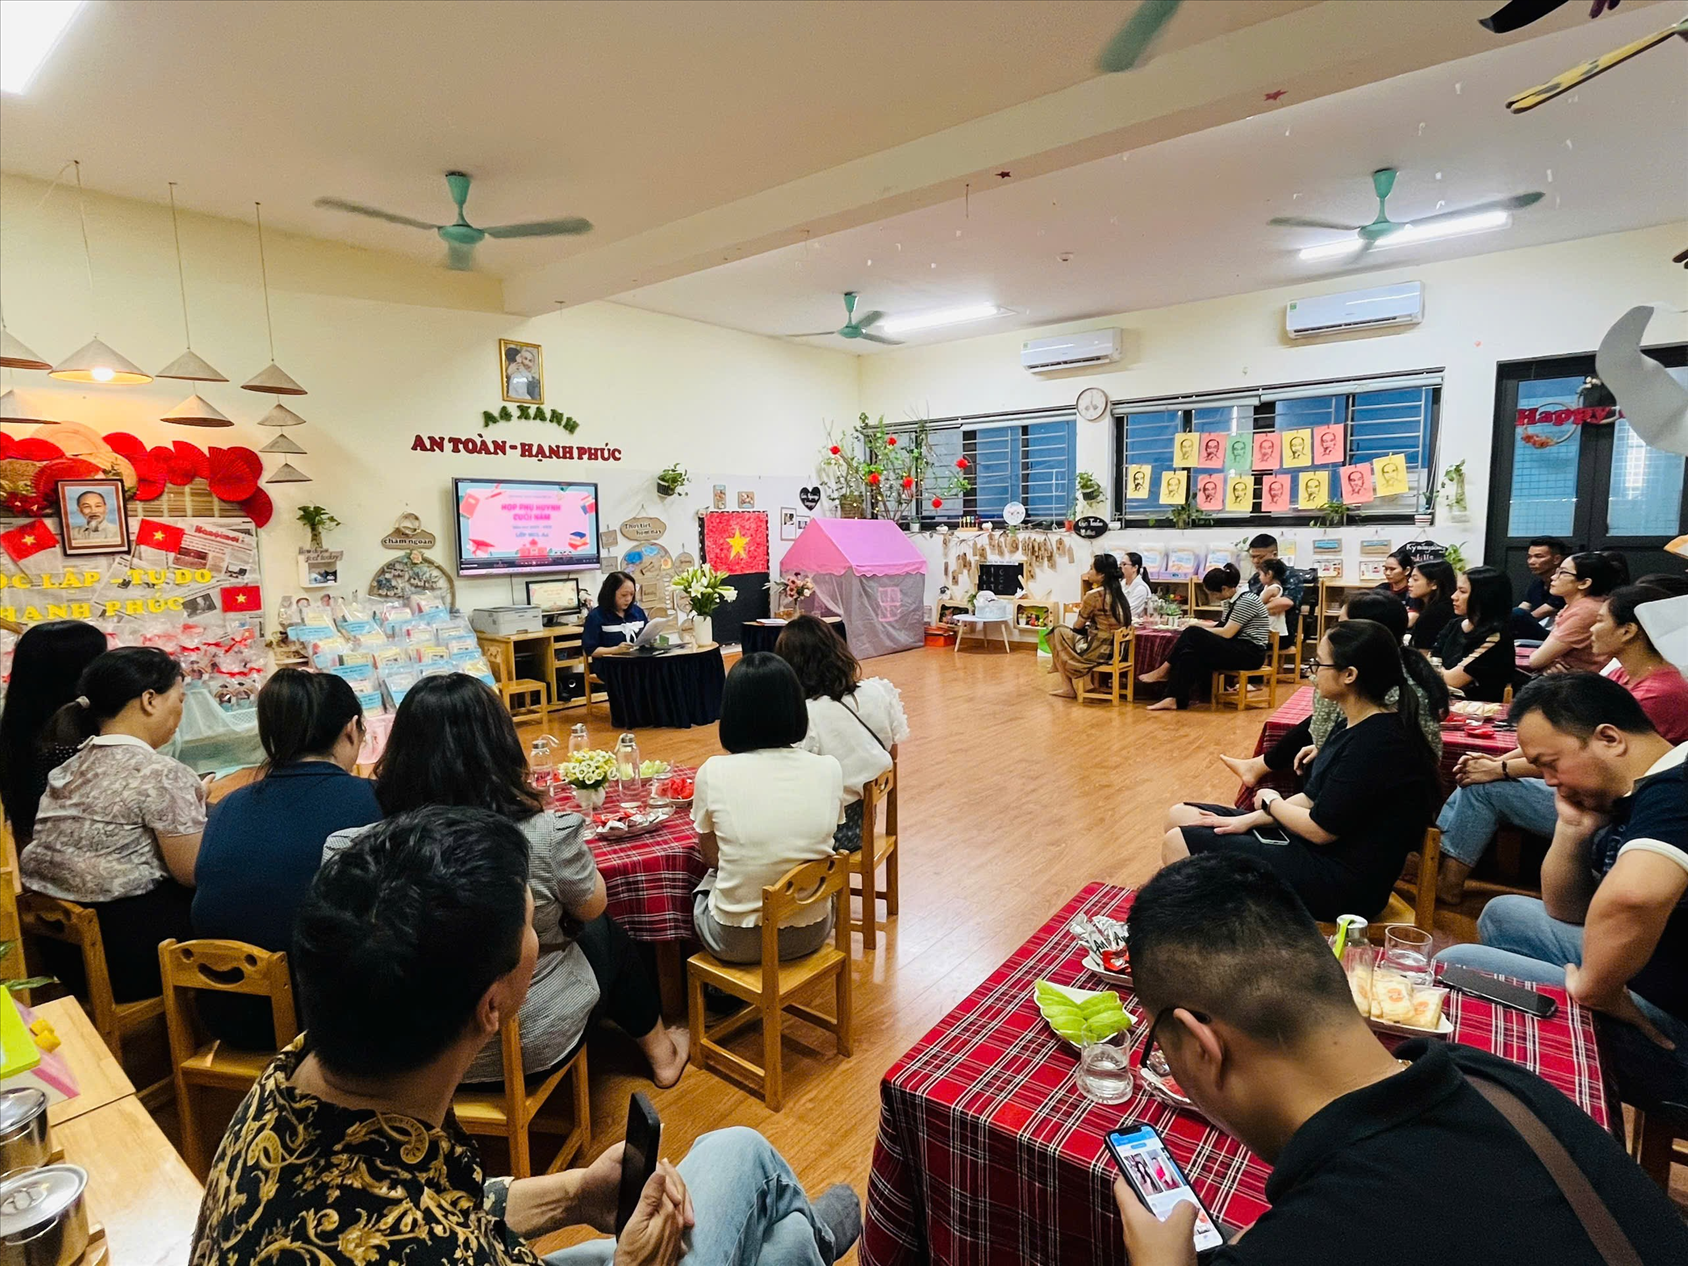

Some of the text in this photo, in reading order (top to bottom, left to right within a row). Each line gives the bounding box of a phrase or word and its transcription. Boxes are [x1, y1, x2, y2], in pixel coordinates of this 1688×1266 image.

[482, 404, 580, 435] A4 XANH
[1515, 407, 1612, 426] Happy
[411, 434, 445, 452] AN
[448, 433, 507, 455] TOÀN
[519, 442, 574, 461] HẠNH
[576, 442, 622, 461] PHÚC
[41, 568, 100, 594] LẬP
[174, 569, 212, 585] DO
[105, 592, 184, 616] PHÚC
